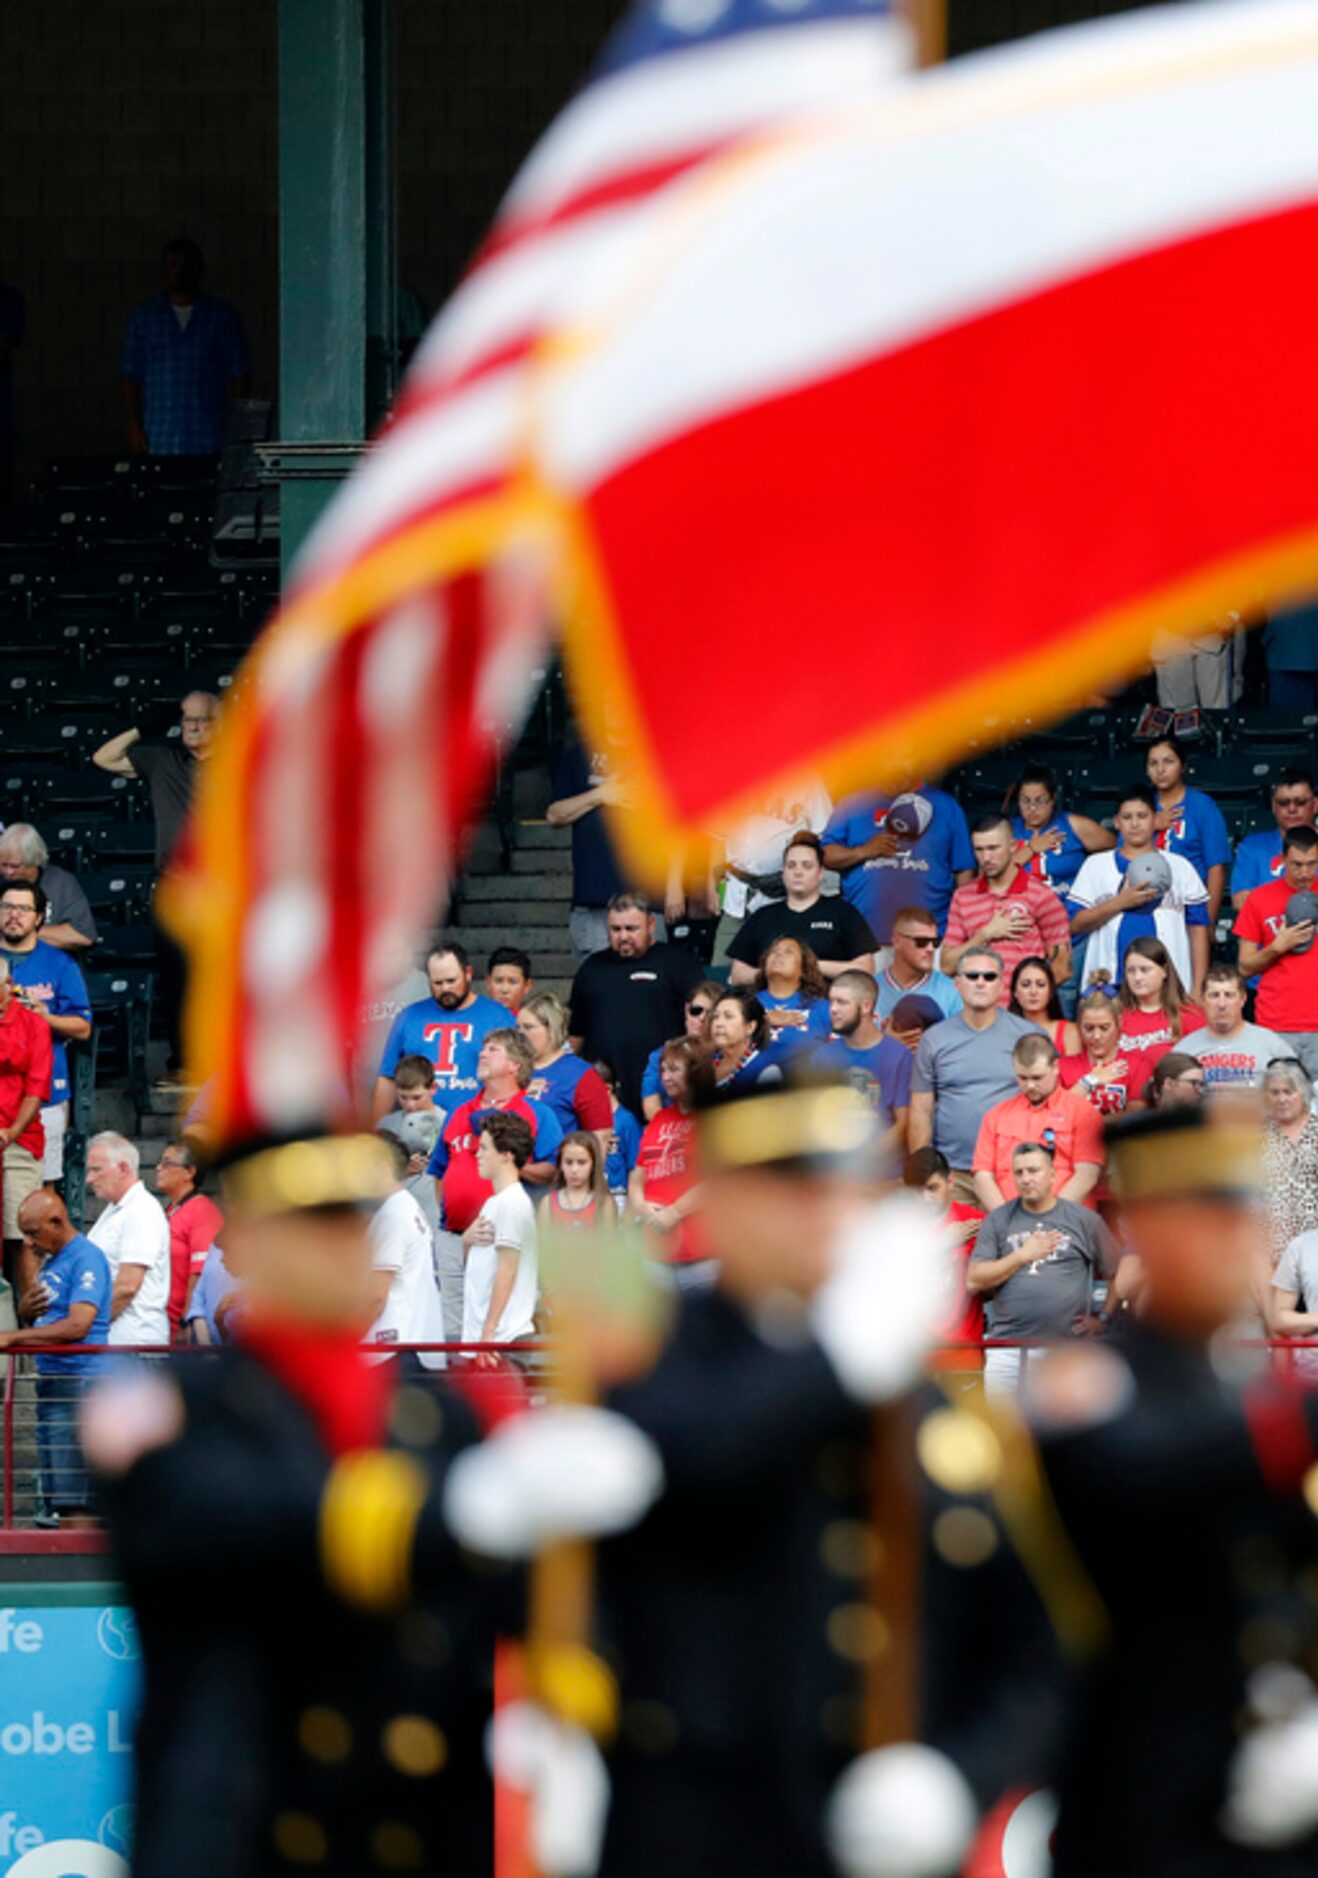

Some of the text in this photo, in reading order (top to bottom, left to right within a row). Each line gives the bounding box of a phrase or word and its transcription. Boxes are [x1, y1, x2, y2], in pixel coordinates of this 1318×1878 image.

[423, 1023, 474, 1075] T
[1198, 1053, 1256, 1070] ANGERS
[1205, 1068, 1256, 1083] SEBALL
[0, 1608, 44, 1653] fe
[1, 1711, 96, 1755] obe
